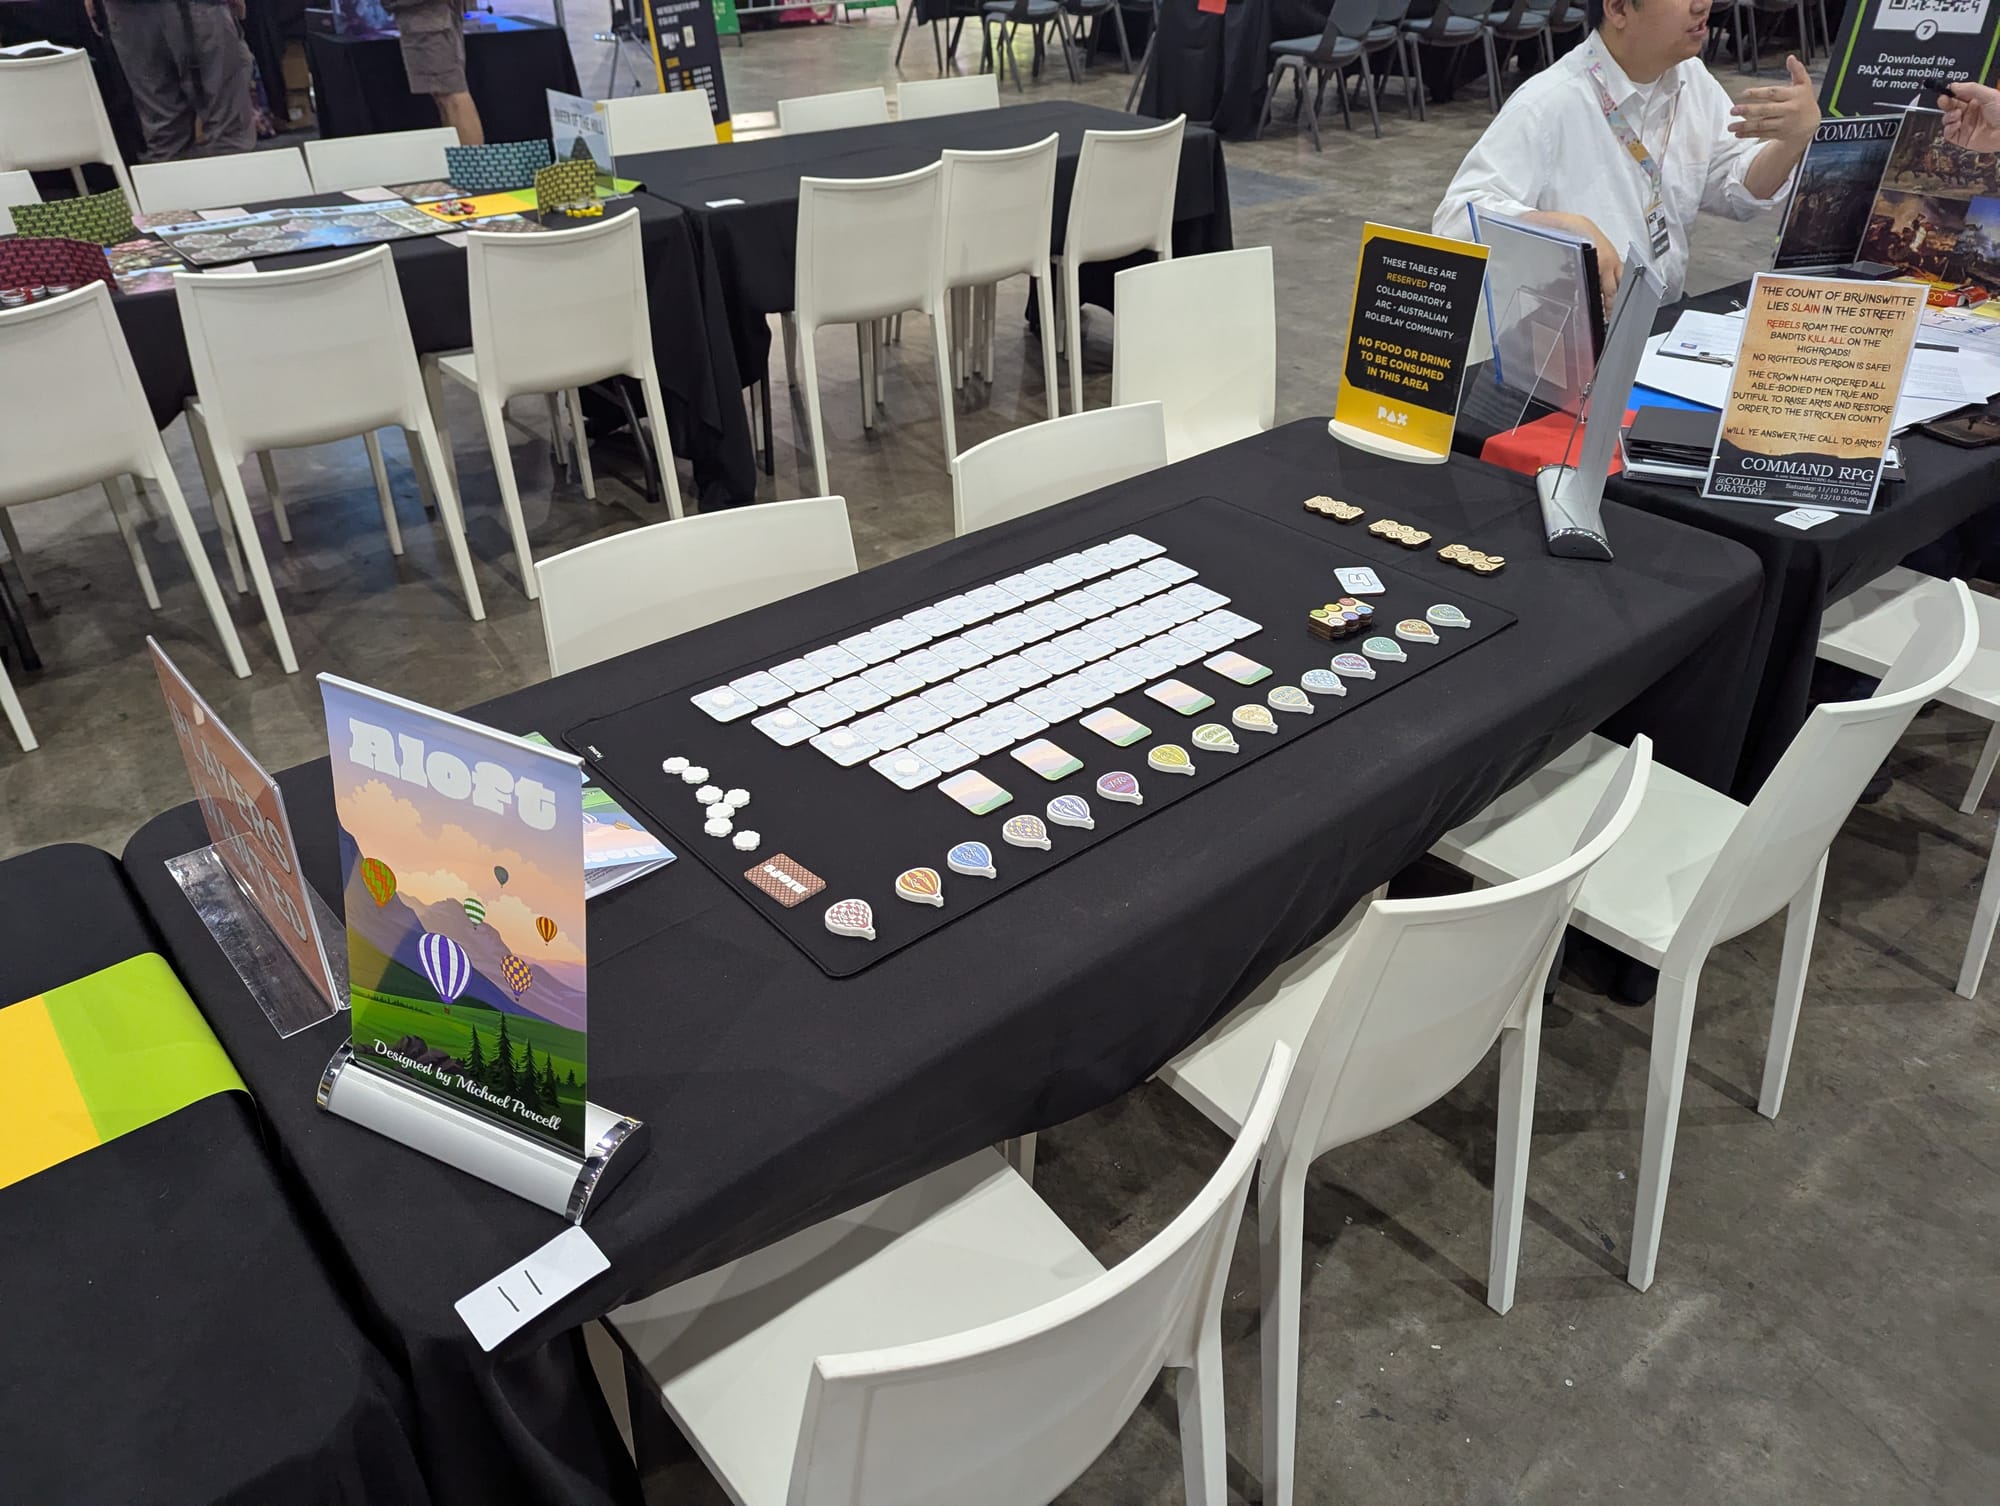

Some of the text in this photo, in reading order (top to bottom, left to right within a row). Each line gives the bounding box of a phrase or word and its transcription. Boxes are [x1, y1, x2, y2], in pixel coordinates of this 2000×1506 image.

[1922, 25, 1932, 35] 7
[1878, 53, 1956, 66] Download the
[1857, 65, 1969, 81] PAX Aus mobile app
[1872, 77, 1888, 88] for
[1889, 80, 1919, 90] more
[1814, 121, 1898, 142] COMMAND
[1382, 256, 1458, 280] THESE TABLES ARE
[1386, 272, 1447, 293] RESERVED FOR
[1376, 284, 1452, 310] COLLABORATORY &
[1762, 286, 1916, 307] THE COUNT OF BRUINSWITTE
[1375, 300, 1393, 310] ARC
[1398, 304, 1448, 323] AUSTRALIAN
[1767, 301, 1906, 320] LIES SLAIN IN THE STREET!
[1364, 311, 1454, 340] ROLEPLAY COMMUNITY
[1767, 319, 1894, 339] REBELS ROAM THE COUNTRY!
[1770, 331, 1881, 348] BANDITS KILL ALL ON THE
[1358, 335, 1452, 369] NO FOOD OR DRINK
[1796, 346, 1851, 357] HIGHROADS!
[1360, 350, 1444, 381] TO BE CONSUMED
[1752, 353, 1891, 372] NO RIGHTEOUS PERSON IS SAFE!
[1367, 366, 1430, 392] IN THIS AREA
[1748, 370, 1886, 390] THE CROWN HATH ORDERED ALL
[1751, 381, 1879, 400] ABLE-BODIED MEN TRUE AND
[1732, 391, 1894, 414] DUTIFUL TO RAISE ARMS AND RESTORE
[1377, 406, 1408, 426] PAX
[1737, 403, 1884, 424] ORDER TO THE STRICKEN COUNTY
[1726, 427, 1882, 449] WILL YE ANSWER THE CALL TO ARMS?
[1741, 457, 1875, 482] COMMAND RPG
[1715, 476, 1767, 488] @COLLAB
[1715, 484, 1766, 496] ORATORY
[1785, 483, 1817, 493] Saturday
[1817, 486, 1839, 494] 11/10
[1792, 491, 1818, 500] Sunday
[1820, 493, 1841, 501] 12/10
[1348, 573, 1373, 587] 4
[349, 717, 557, 831] Aloft
[170, 696, 292, 875] PLAYERS
[195, 777, 308, 943] WANTED
[373, 1038, 562, 1131] Designed by Michael Purcell
